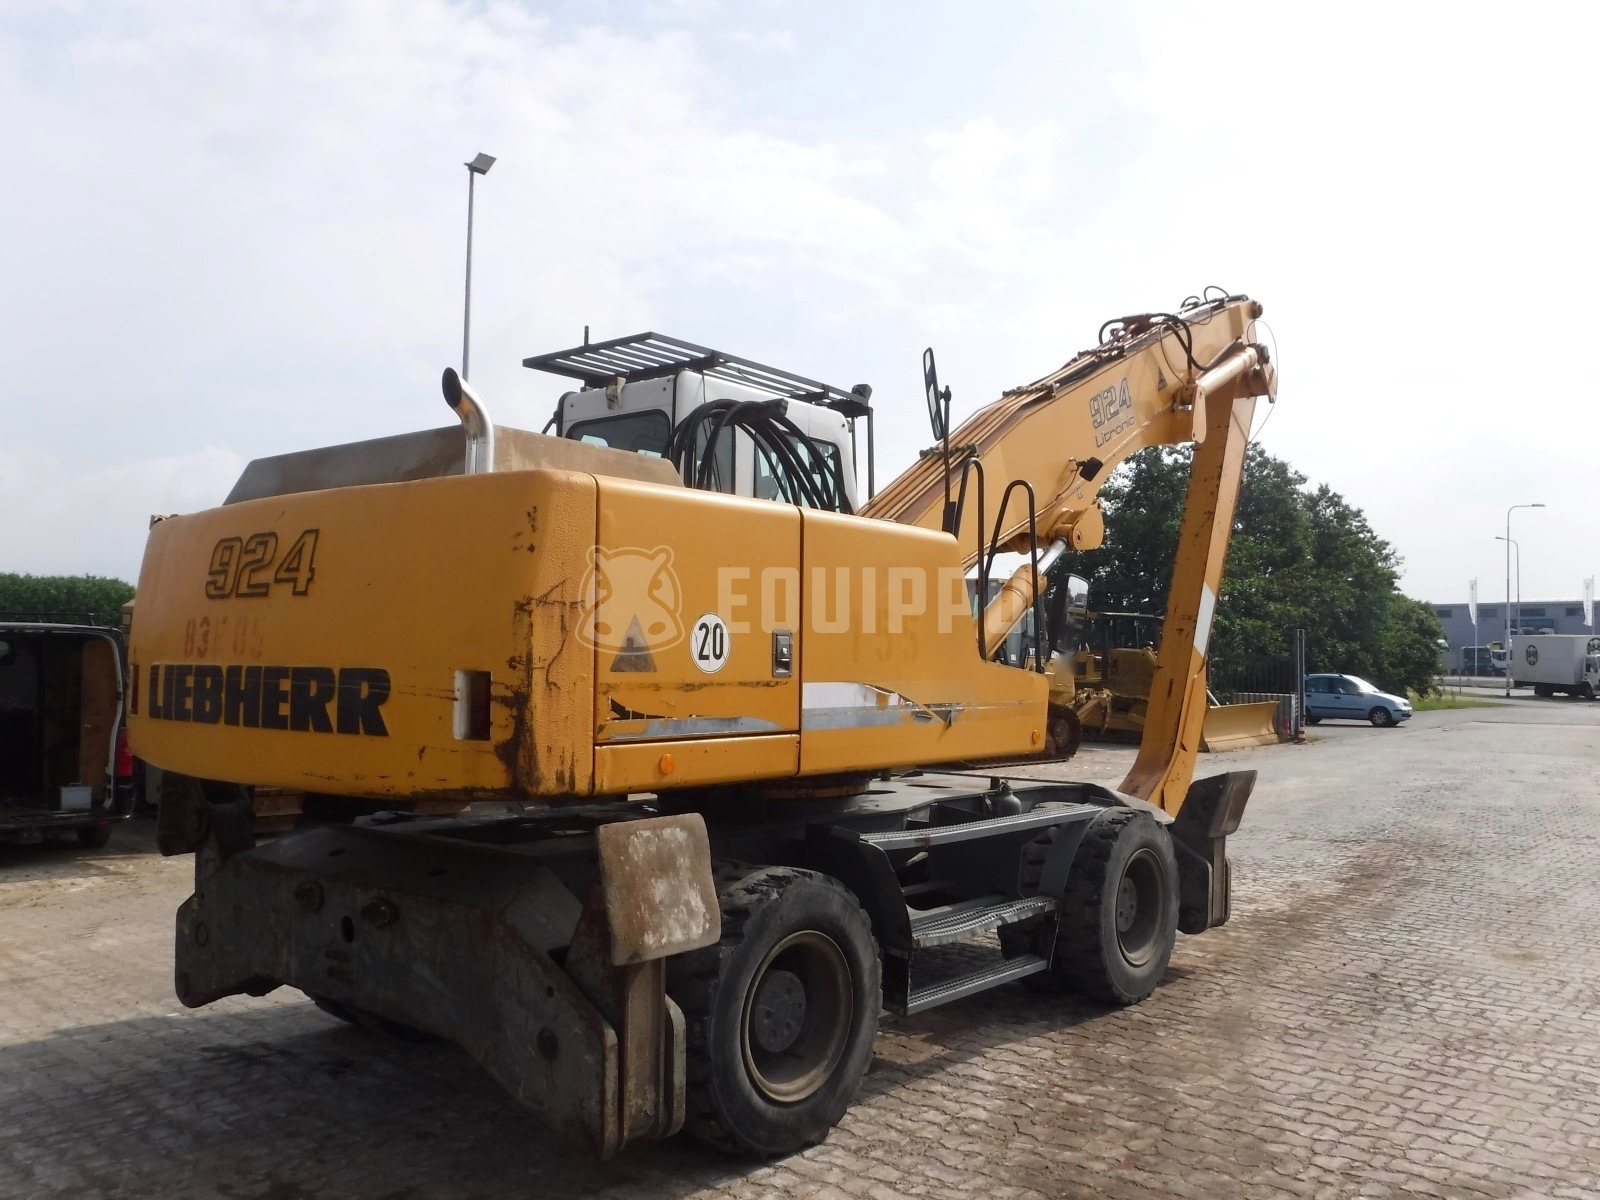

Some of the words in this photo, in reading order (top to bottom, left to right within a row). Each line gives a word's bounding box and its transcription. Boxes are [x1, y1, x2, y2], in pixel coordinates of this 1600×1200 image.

[1089, 377, 1131, 429] 924
[1095, 416, 1136, 448] Litronic
[205, 528, 320, 599] 924
[698, 622, 724, 661] 20
[149, 664, 391, 736] LIEBHERR
